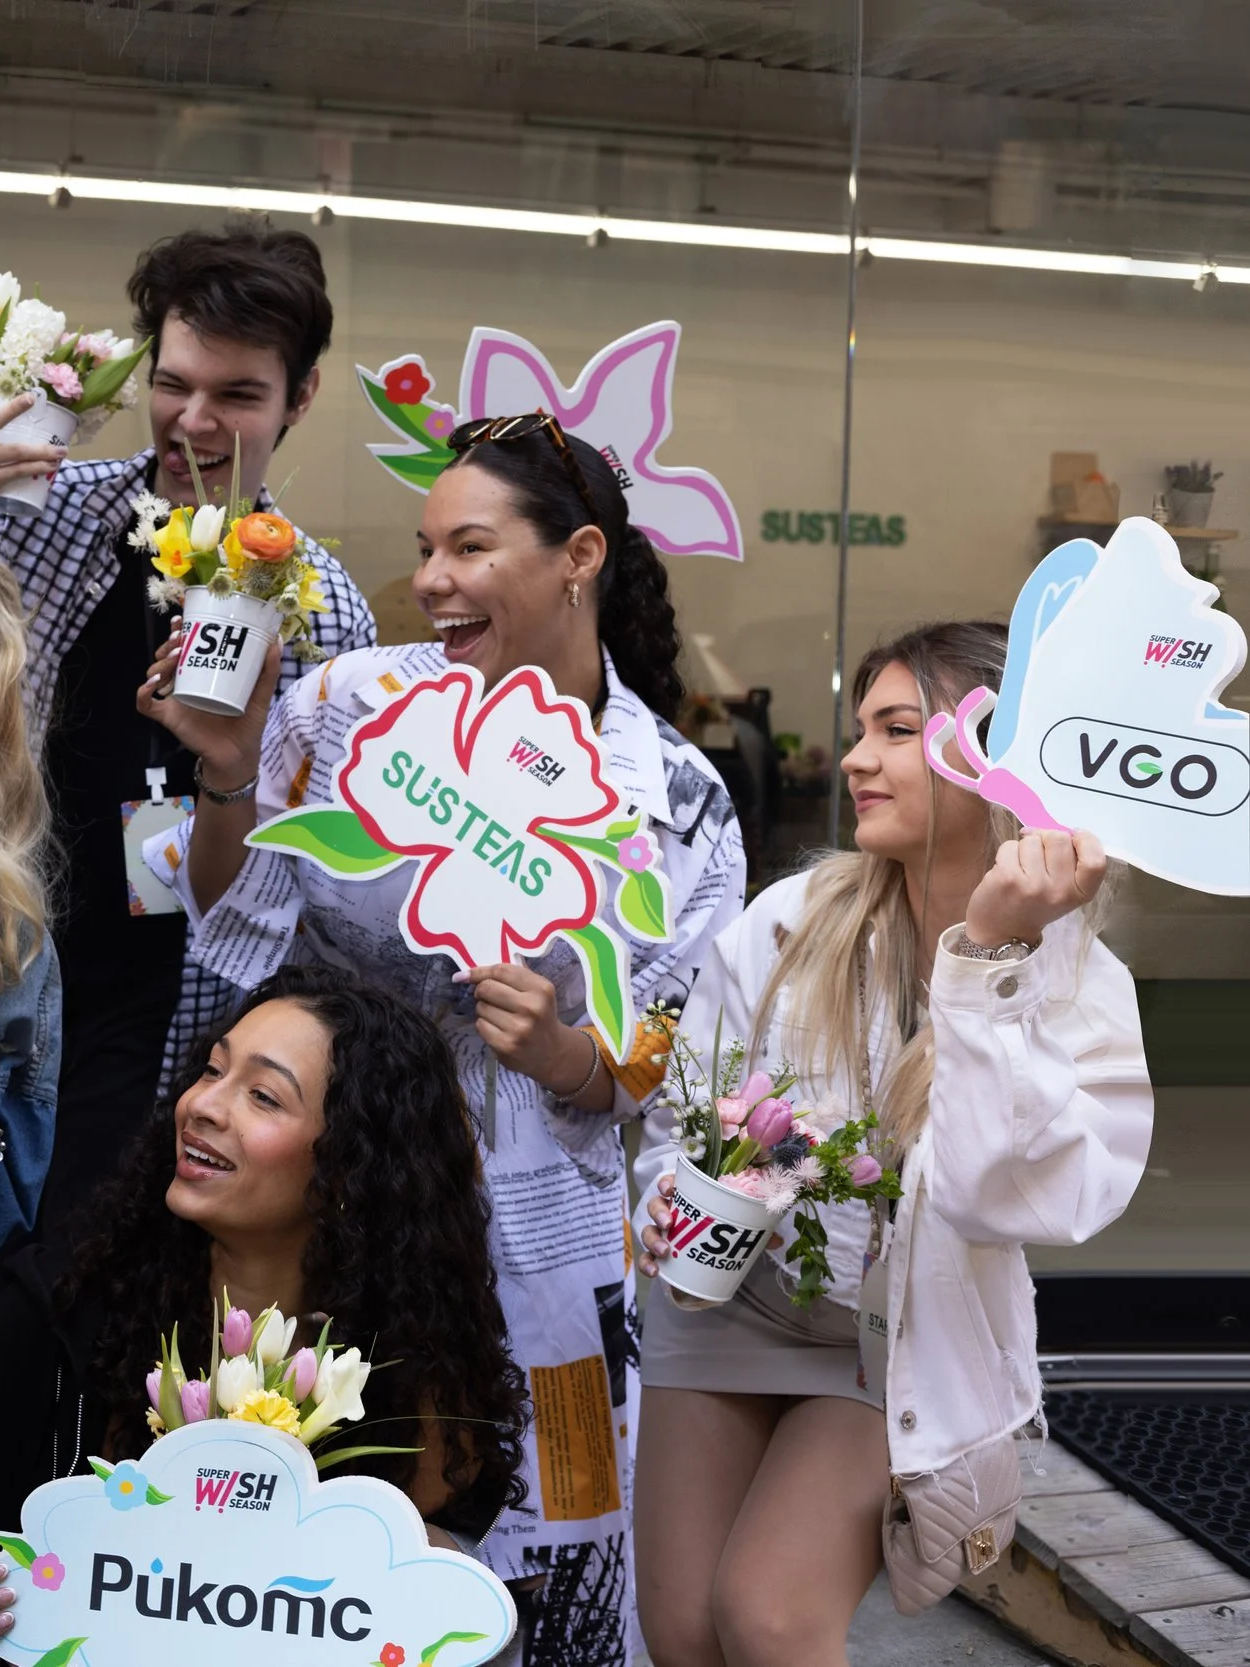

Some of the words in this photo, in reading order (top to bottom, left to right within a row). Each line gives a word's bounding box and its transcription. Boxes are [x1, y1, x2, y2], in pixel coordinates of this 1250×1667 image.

[760, 509, 907, 548] SUSTEAS
[1149, 634, 1177, 645] SUPER
[187, 655, 239, 672] SEASON
[1170, 658, 1204, 669] SEASON
[518, 736, 540, 753] SUPER
[1079, 732, 1217, 799] VGO
[527, 766, 553, 787] SEASON
[382, 750, 552, 897] SUSTEAS
[686, 1247, 745, 1272] SEASON
[196, 1468, 231, 1480] SUPER
[229, 1498, 271, 1512] SEASON
[89, 1553, 373, 1642] Pukomc
